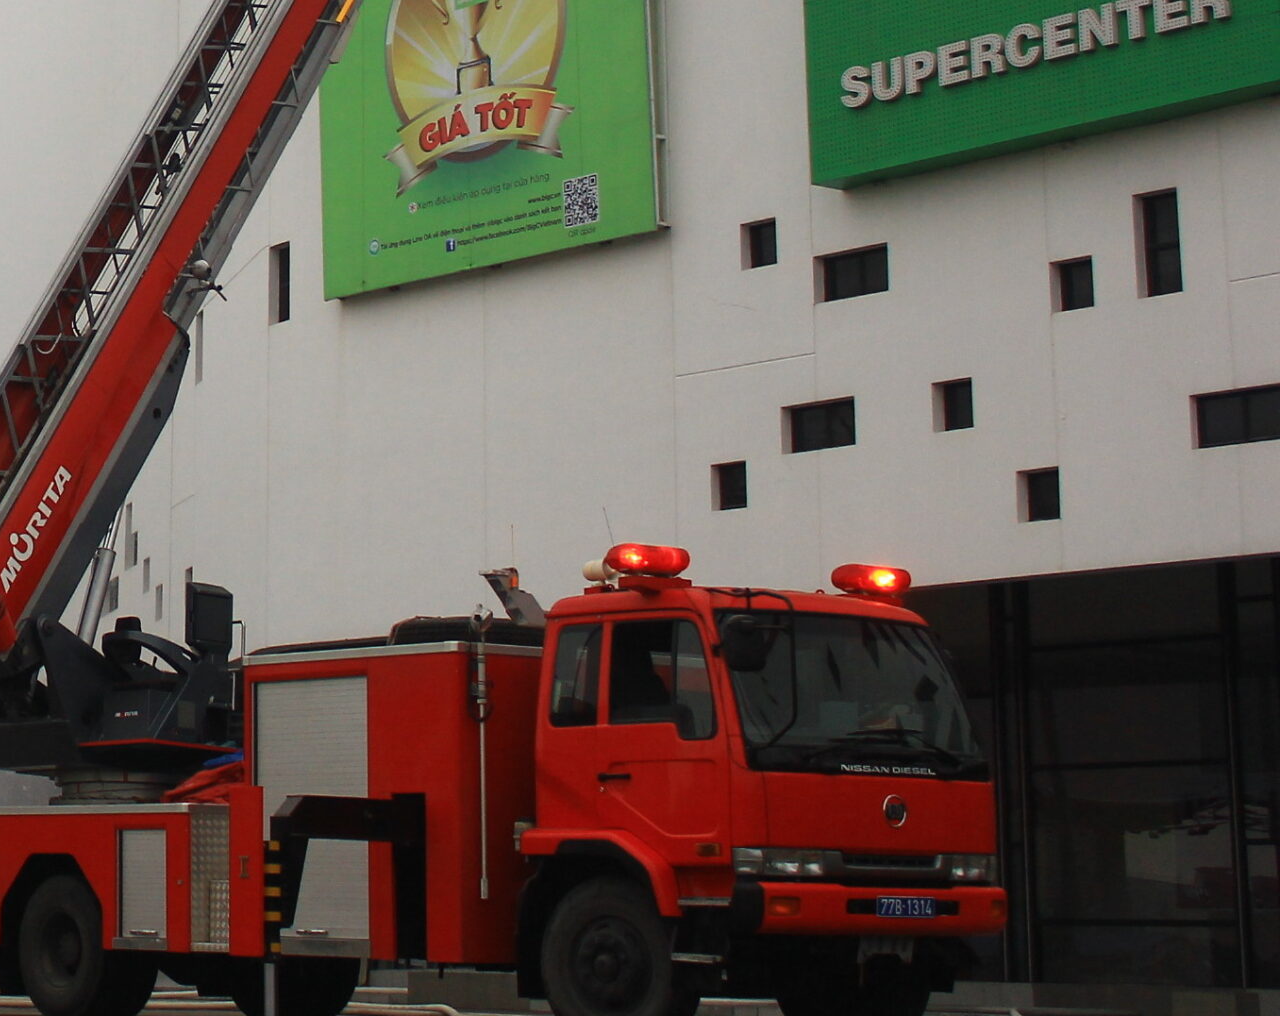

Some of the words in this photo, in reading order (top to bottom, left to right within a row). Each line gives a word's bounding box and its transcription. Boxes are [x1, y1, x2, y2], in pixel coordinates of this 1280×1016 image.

[419, 103, 471, 152] GIÁ
[474, 91, 533, 133] TỐT
[0, 465, 72, 594] MORITA
[840, 764, 890, 774] NISSAN
[892, 766, 937, 776] DIESEL
